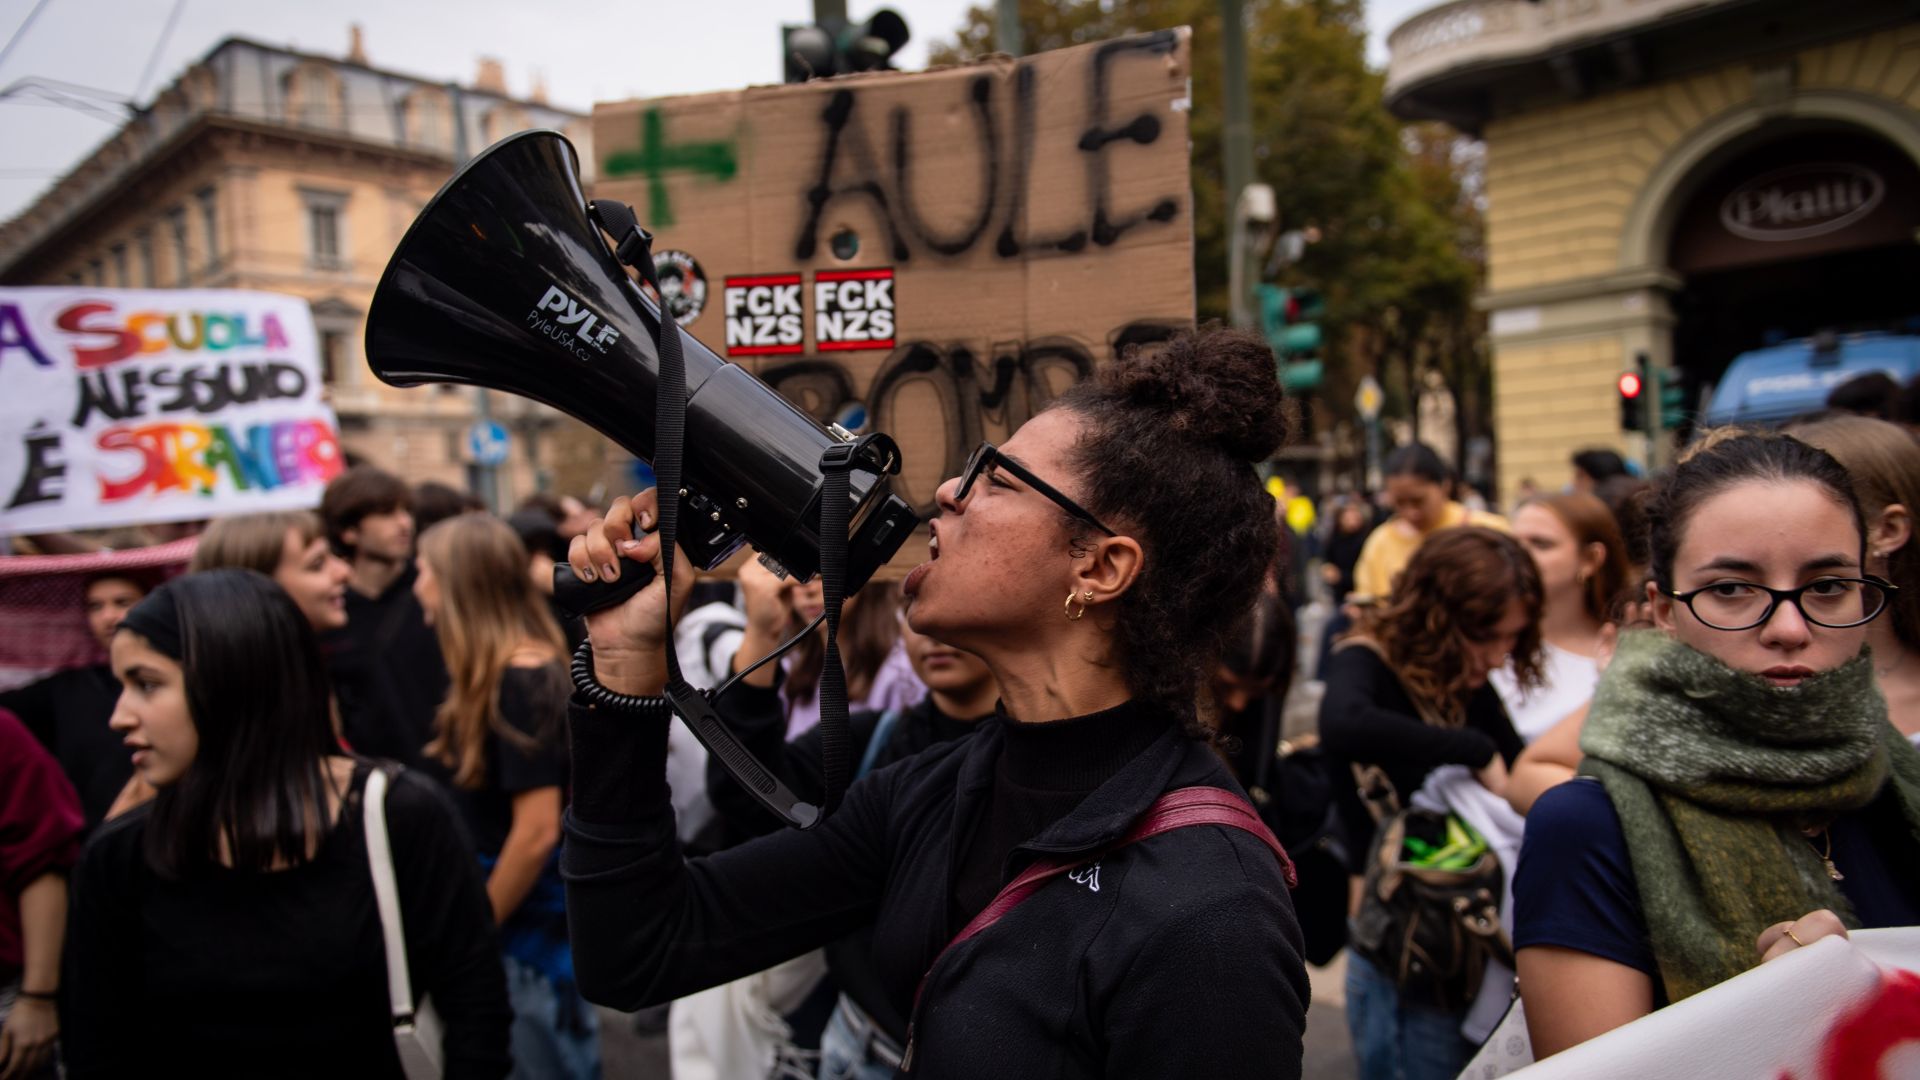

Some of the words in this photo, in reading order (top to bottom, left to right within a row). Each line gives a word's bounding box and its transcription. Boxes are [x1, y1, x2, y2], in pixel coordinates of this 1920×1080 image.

[796, 30, 1179, 260] AULE
[725, 284, 802, 316] FCK
[815, 279, 893, 311] FCK
[55, 300, 289, 369] SCUOLA
[727, 315, 803, 346] NZS
[816, 309, 895, 342] NZS
[71, 362, 307, 428] NESSUNO
